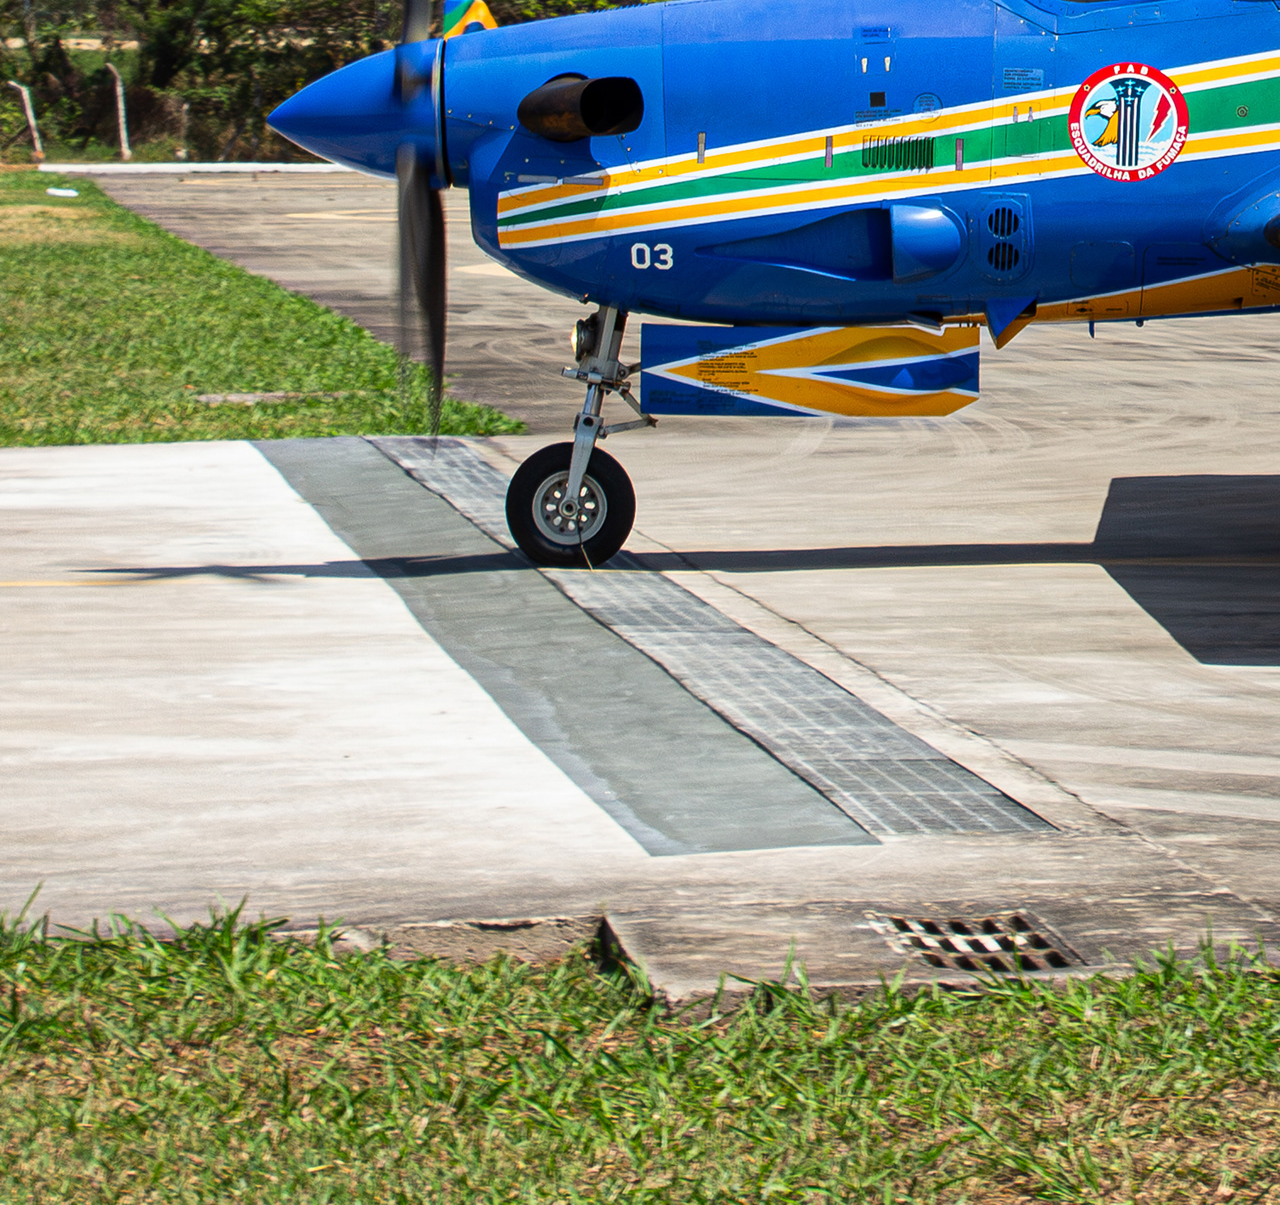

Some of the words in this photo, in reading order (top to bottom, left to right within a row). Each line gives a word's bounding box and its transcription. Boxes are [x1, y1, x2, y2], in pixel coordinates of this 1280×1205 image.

[1113, 64, 1149, 75] FAB
[1070, 122, 1131, 181] ESQUADRILHA
[1138, 167, 1155, 179] DA
[1155, 125, 1187, 171] FUMAÇA
[631, 242, 674, 271] 03
